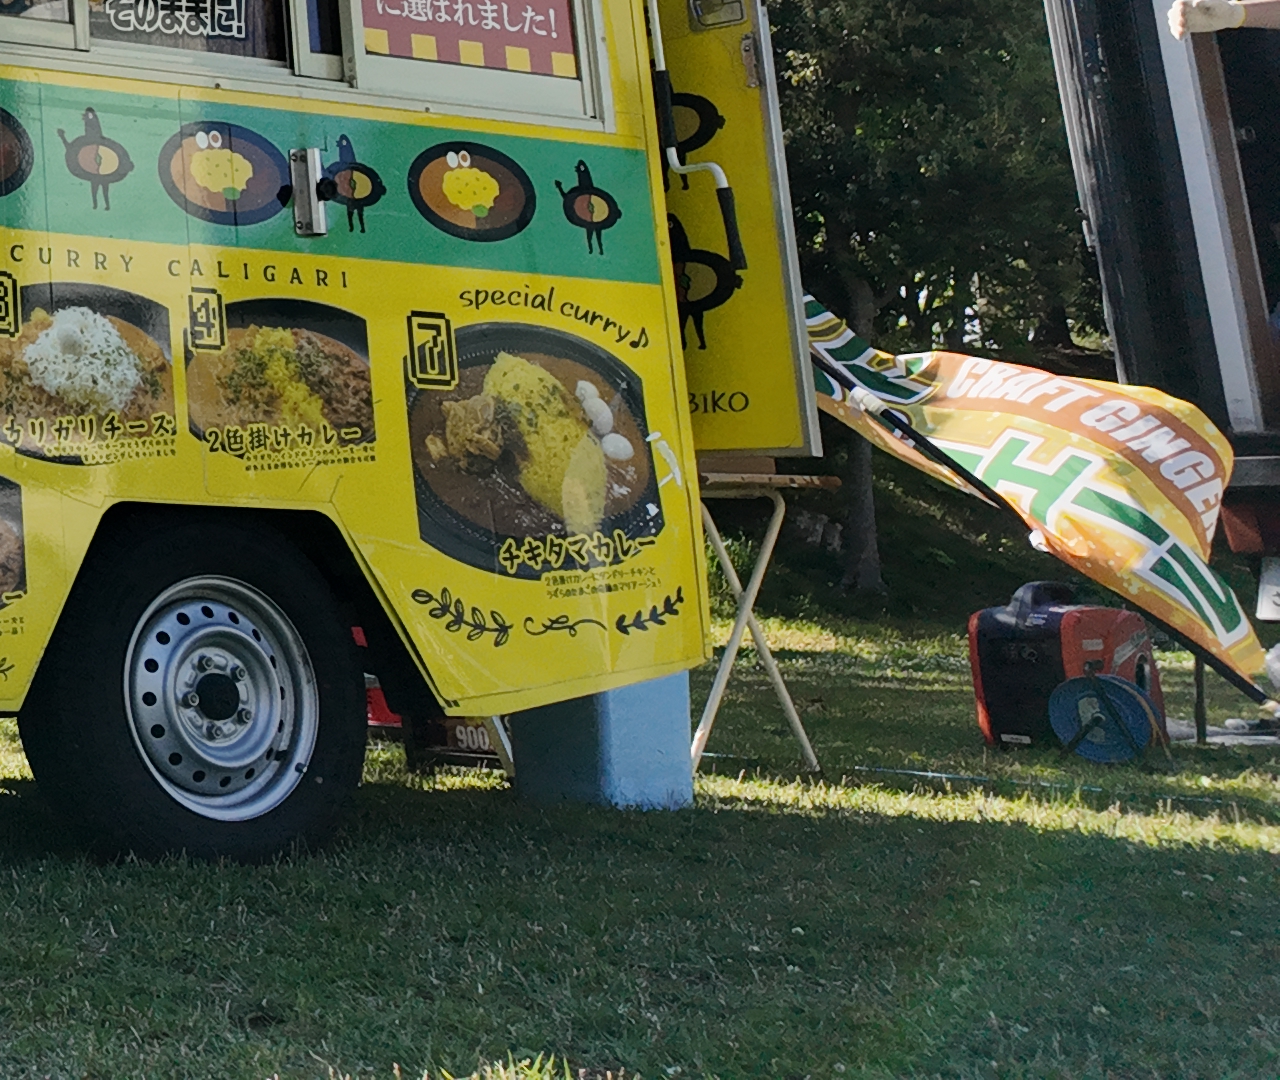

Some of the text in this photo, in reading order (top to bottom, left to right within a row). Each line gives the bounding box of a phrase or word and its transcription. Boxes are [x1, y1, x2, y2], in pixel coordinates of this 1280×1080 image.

[9, 244, 135, 273] CURRY
[167, 259, 349, 289] CALIGARI
[458, 285, 556, 313] special
[950, 356, 1103, 414] CRAFT
[4, 414, 175, 447] カリガリチーズ
[208, 424, 362, 453] 2色掛けカレー
[500, 530, 657, 569] チキタマカレー
[455, 724, 490, 751] 900
